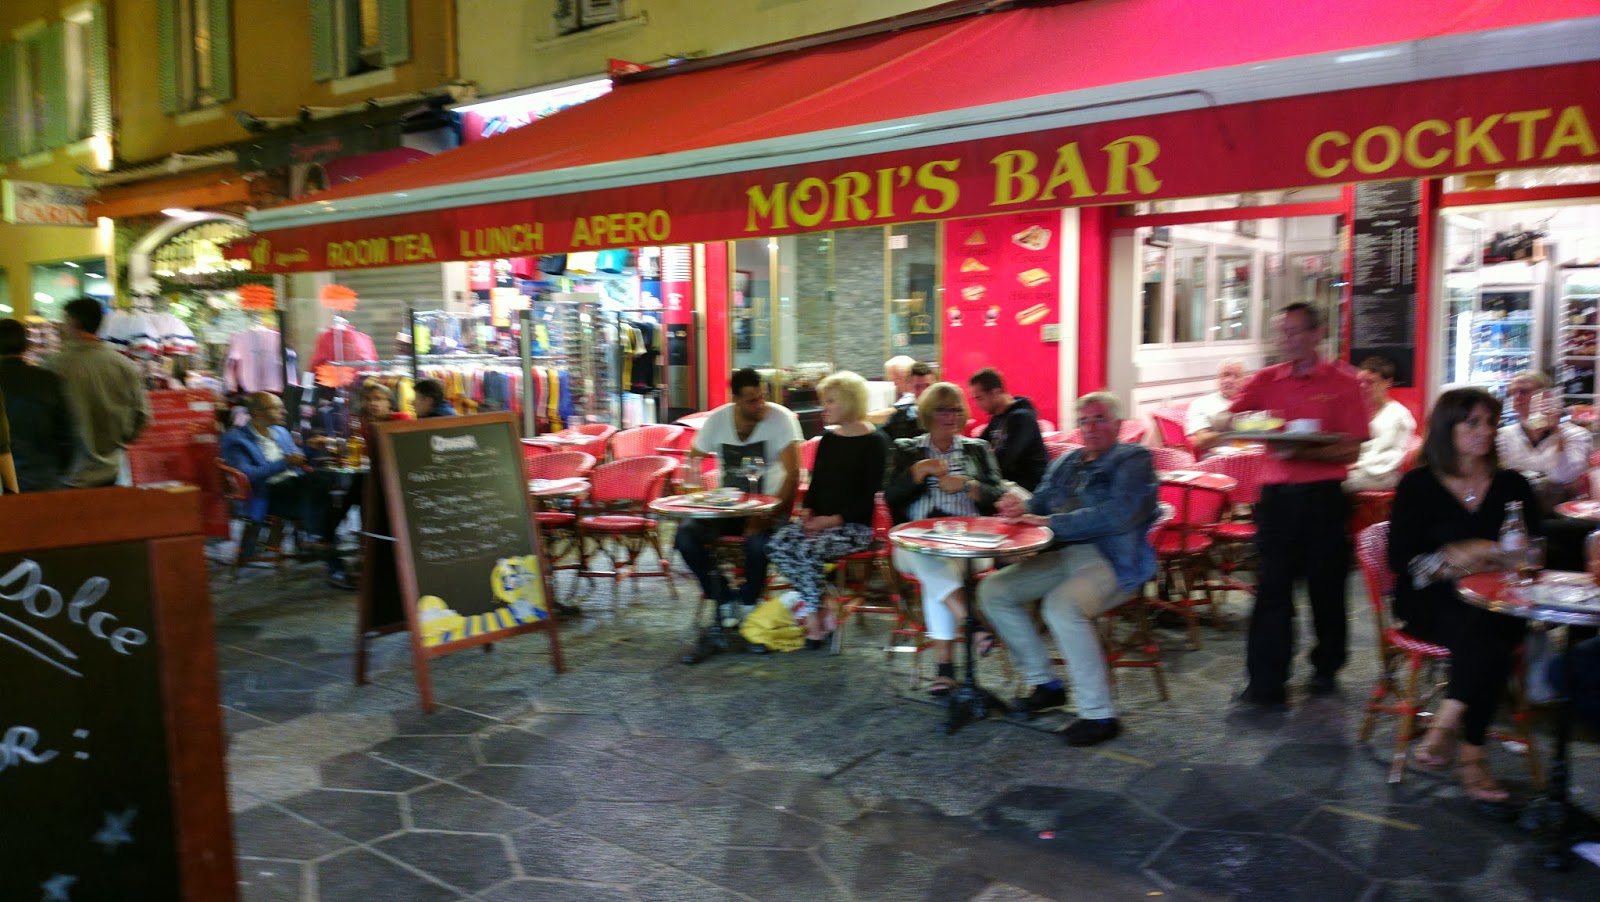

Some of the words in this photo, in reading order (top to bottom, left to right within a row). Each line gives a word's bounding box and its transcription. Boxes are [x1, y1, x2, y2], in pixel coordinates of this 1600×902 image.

[326, 237, 389, 267] ROOM
[390, 232, 437, 261] TEA
[460, 222, 544, 257] LUNCH
[570, 209, 671, 247] APERO
[744, 158, 961, 232] MORI'S
[990, 135, 1163, 206] BAR
[1305, 105, 1599, 179] COCKTA
[0, 559, 148, 655] Dolce
